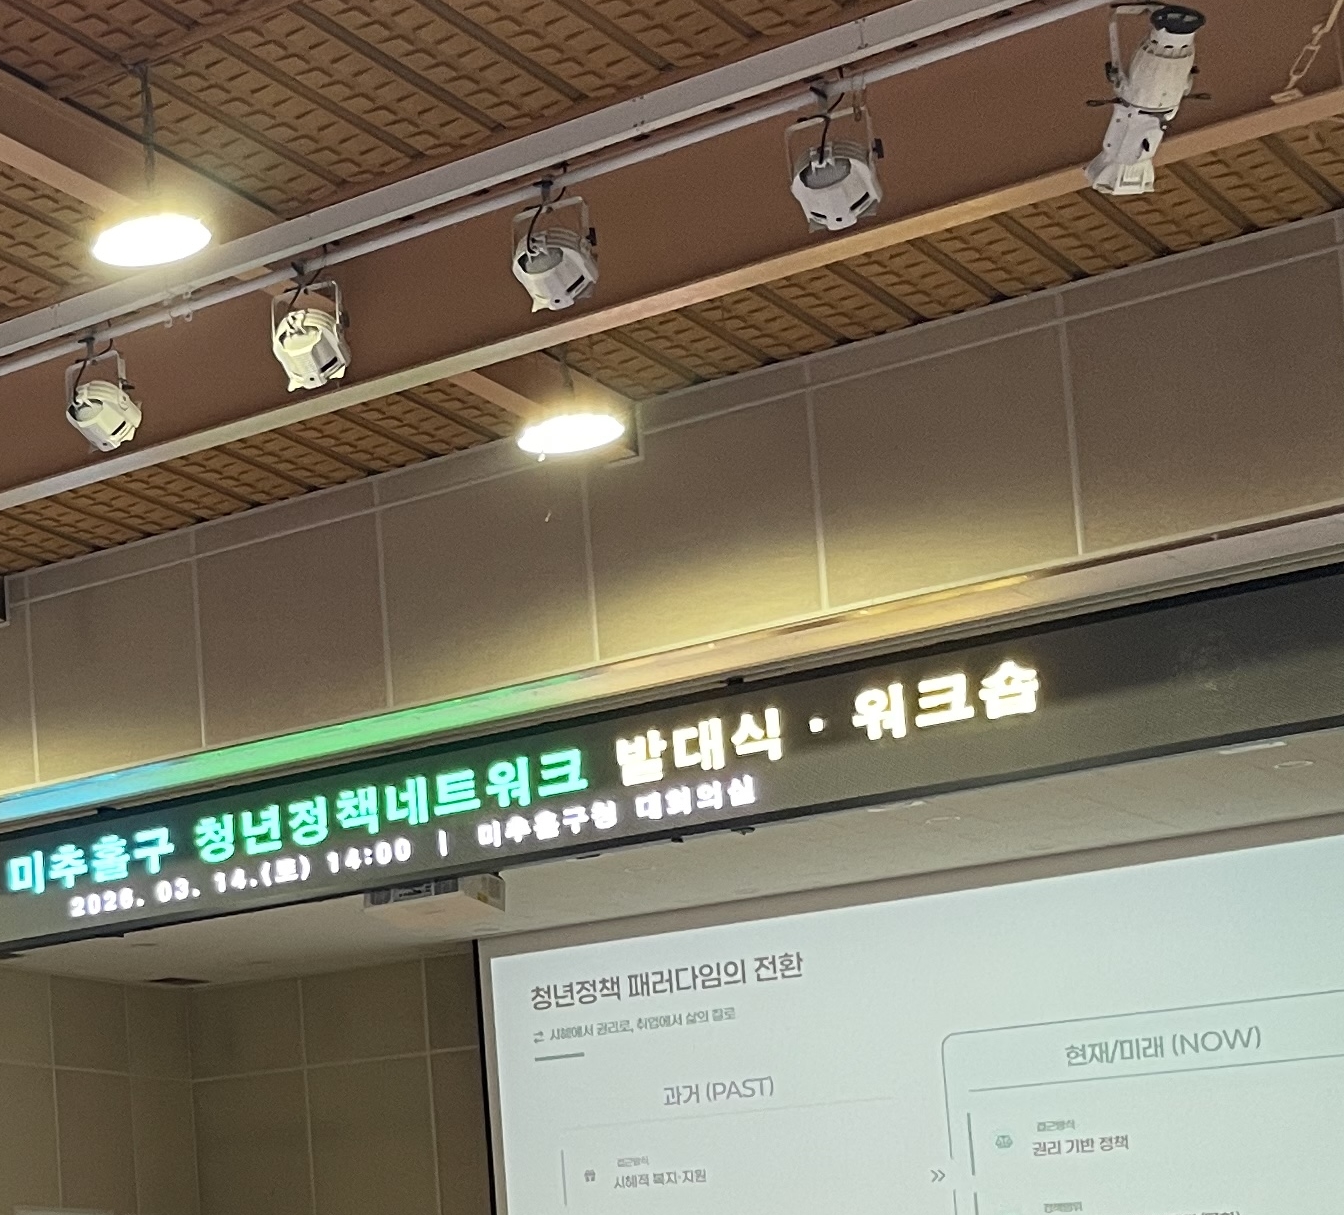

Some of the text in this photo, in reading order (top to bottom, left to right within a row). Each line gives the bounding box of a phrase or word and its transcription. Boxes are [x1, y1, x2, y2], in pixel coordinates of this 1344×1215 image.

[4, 826, 175, 894] 미추홀구
[193, 746, 589, 863] 청년정책네트워크
[616, 706, 785, 787] 발대식
[851, 659, 1040, 742] 워크숍
[155, 877, 201, 903] 03.
[326, 837, 411, 874] 14:00
[477, 800, 617, 847] 미추홀구청
[635, 774, 756, 820] 대회의실
[530, 952, 803, 1011] 청년정책 패러다임의 전환
[637, 1014, 683, 1031] 취업에서
[686, 1009, 709, 1024] 삶의
[1065, 1025, 1262, 1066] 현재/미래 (NOW)
[663, 1075, 774, 1105] 과거 (PAST)
[1032, 1134, 1129, 1156] 권리 기반 정책
[614, 1173, 650, 1188] 시혜적
